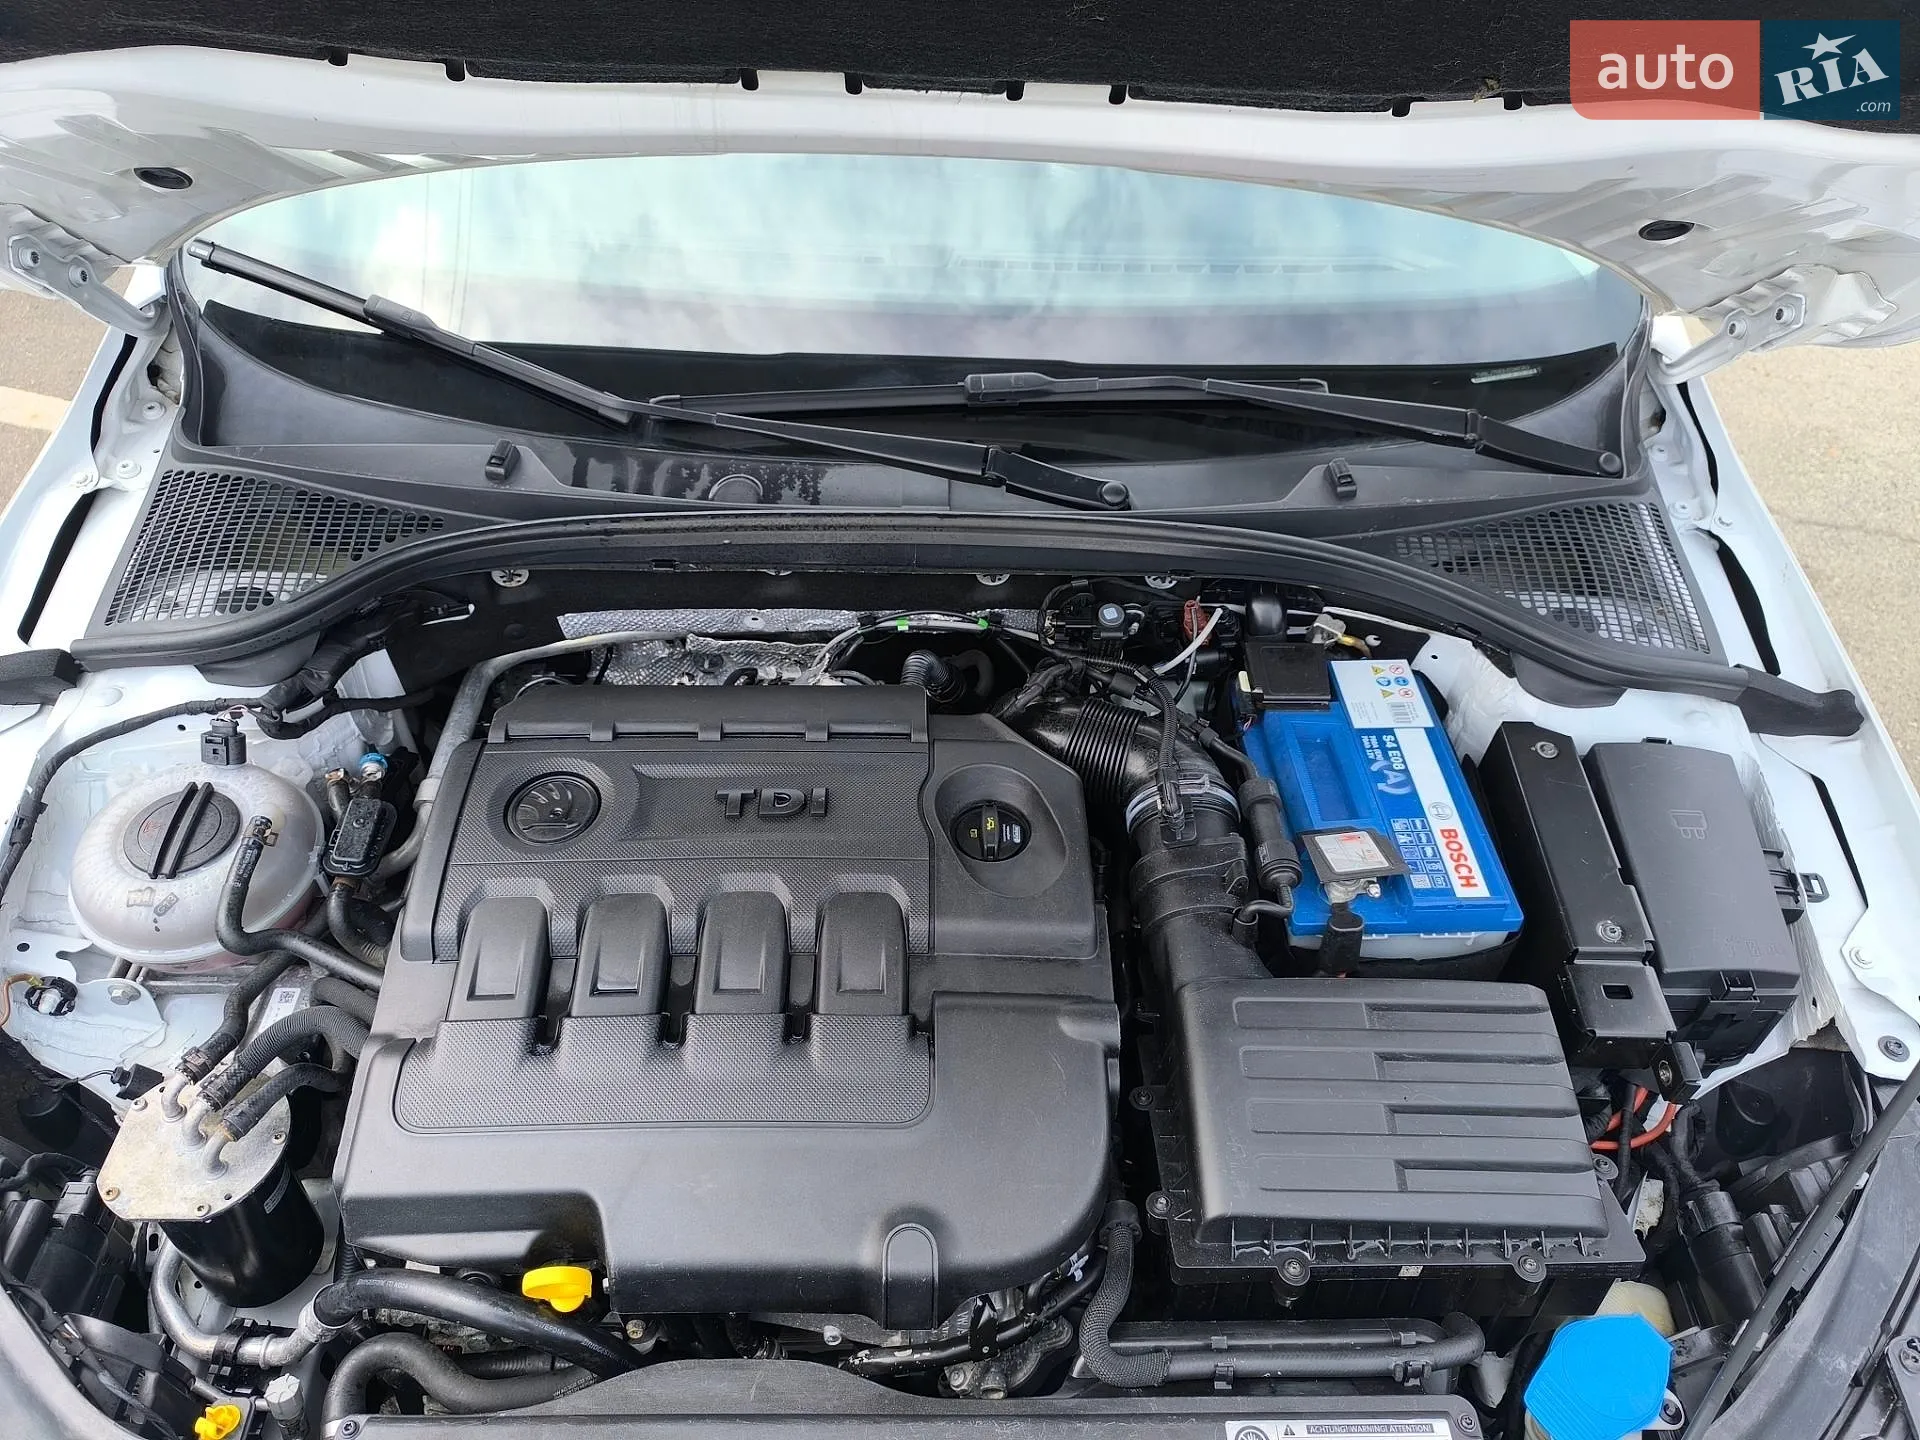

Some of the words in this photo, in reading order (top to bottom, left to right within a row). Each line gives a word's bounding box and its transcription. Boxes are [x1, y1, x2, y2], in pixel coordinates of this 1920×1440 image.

[1382, 735, 1397, 748] S4
[1388, 750, 1405, 770] E08
[714, 787, 828, 820] TDI
[1440, 829, 1478, 888] BOSCH
[1310, 1424, 1348, 1434] ACHTUNG!
[1349, 1424, 1388, 1433] WARNING!
[1389, 1423, 1431, 1433] ATTENTION!
